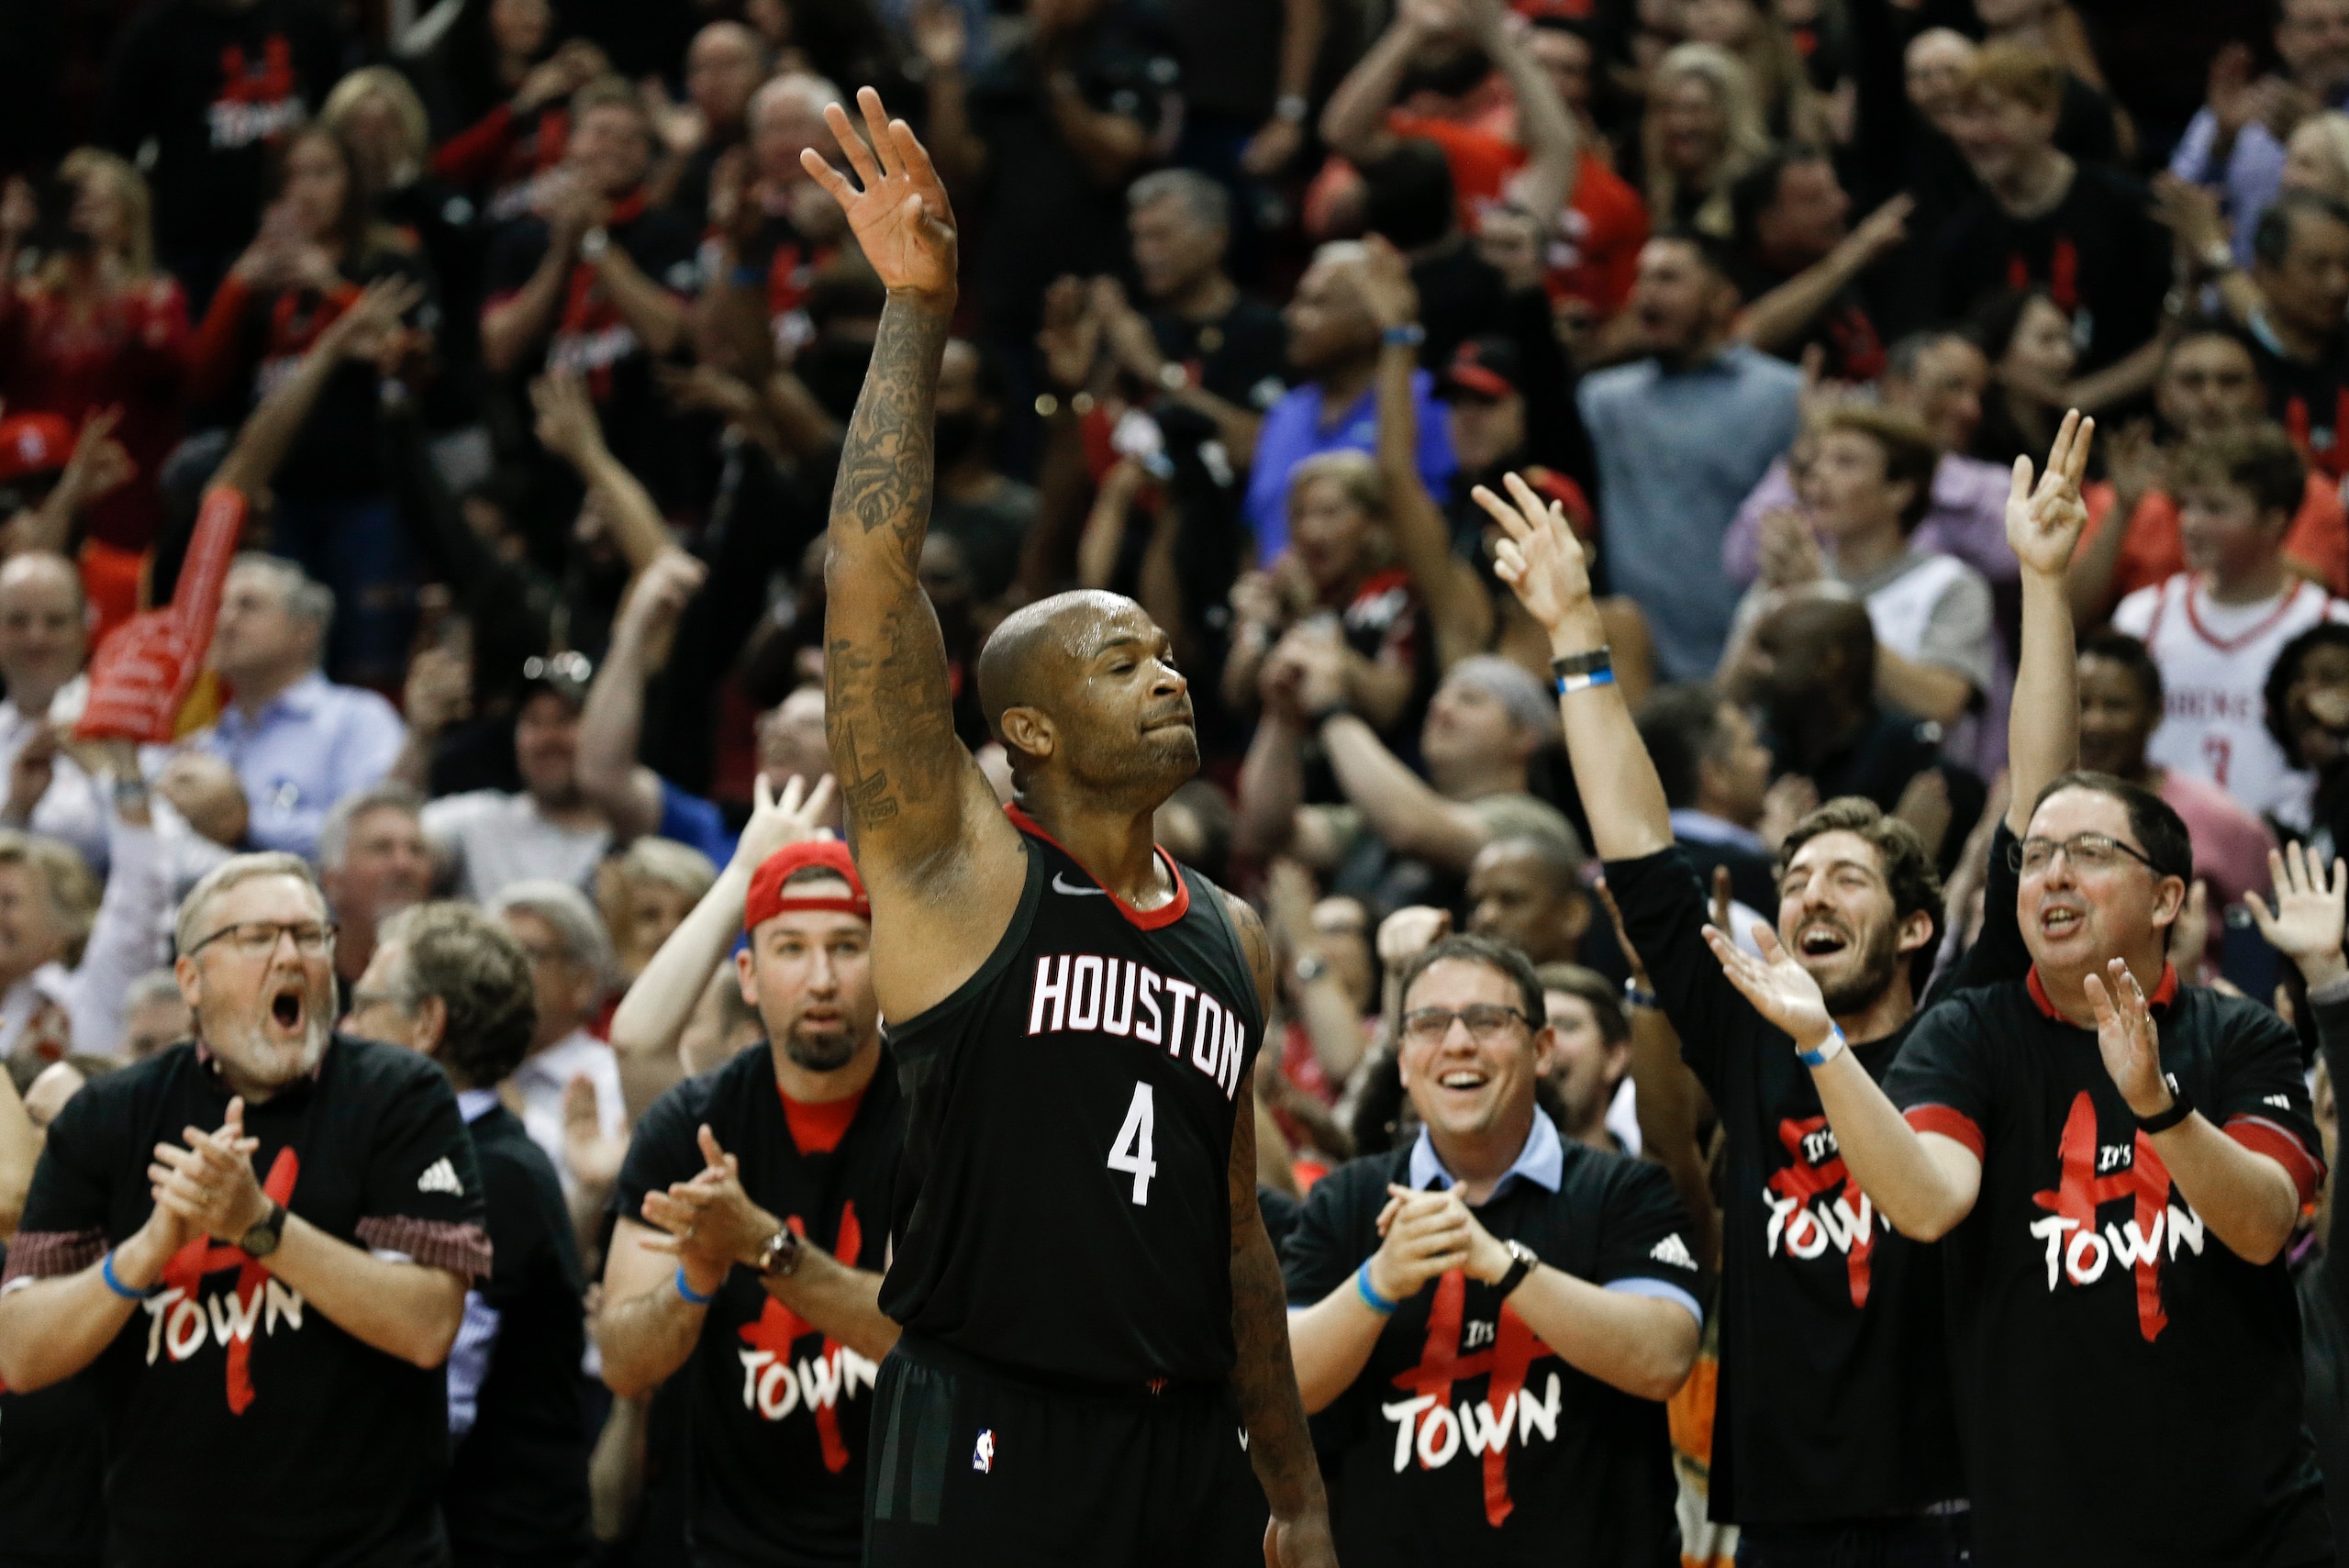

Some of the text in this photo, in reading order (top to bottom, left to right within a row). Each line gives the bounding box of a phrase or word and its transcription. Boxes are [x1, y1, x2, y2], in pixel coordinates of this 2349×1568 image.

[1027, 953, 1246, 1103] HOUSTON
[1107, 1079, 1158, 1207] 4
[1761, 1185, 1892, 1260] TOW
[2029, 1203, 2205, 1294] TOWN
[141, 1276, 304, 1368] TOWN
[1380, 1371, 1564, 1474] TOWN
